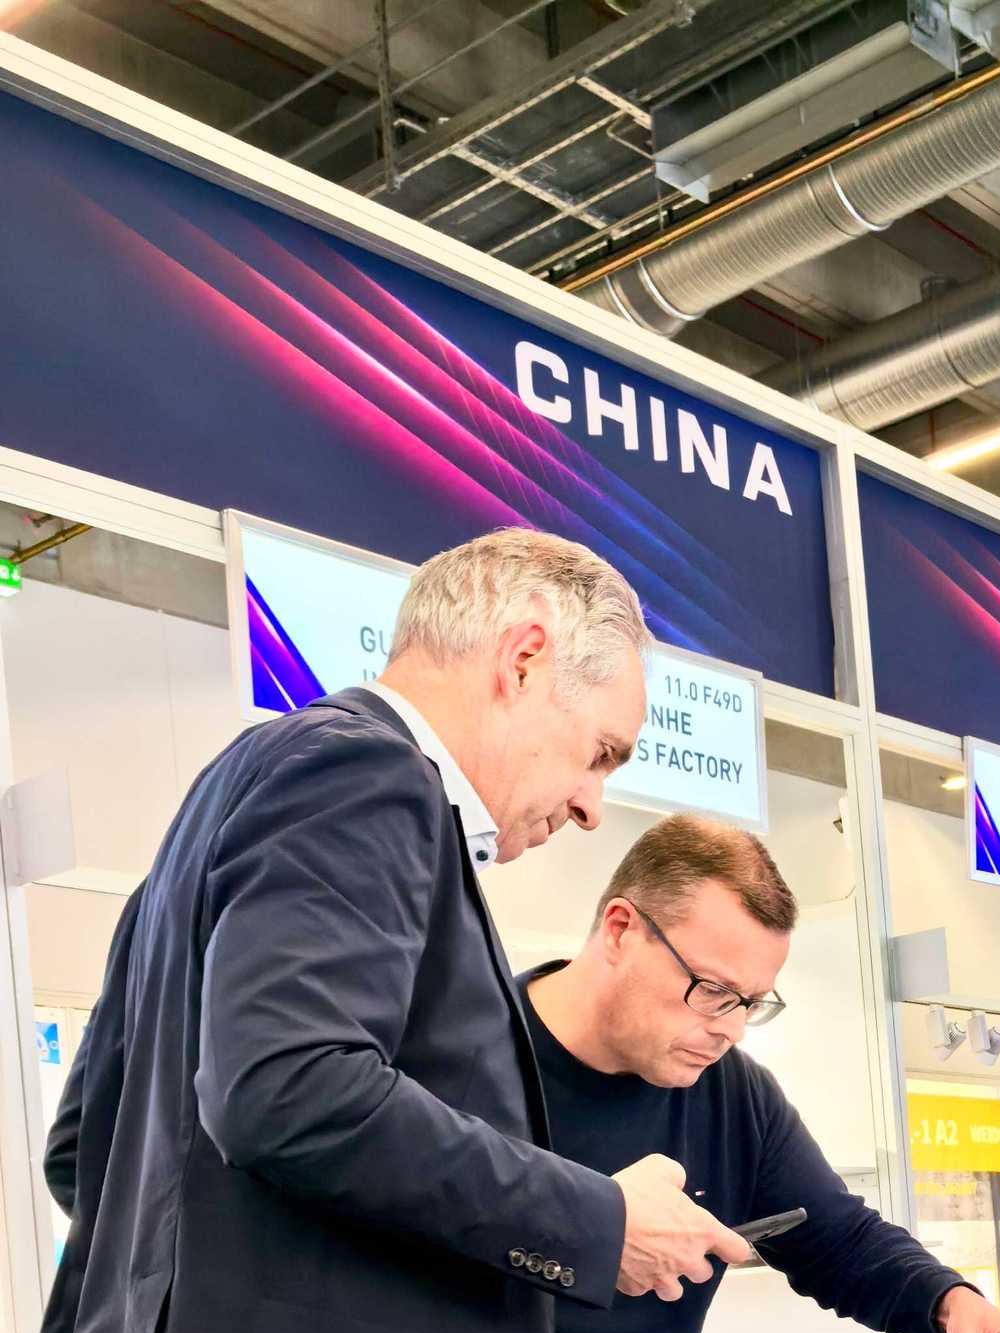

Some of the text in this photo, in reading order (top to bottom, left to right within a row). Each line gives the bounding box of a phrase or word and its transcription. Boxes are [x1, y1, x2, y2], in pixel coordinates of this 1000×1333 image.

[515, 340, 793, 516] CHINA
[665, 675, 742, 713] 11.0 F49D
[645, 703, 692, 736] NHE
[656, 742, 743, 784] FACTORY
[936, 1120, 958, 1146] A2
